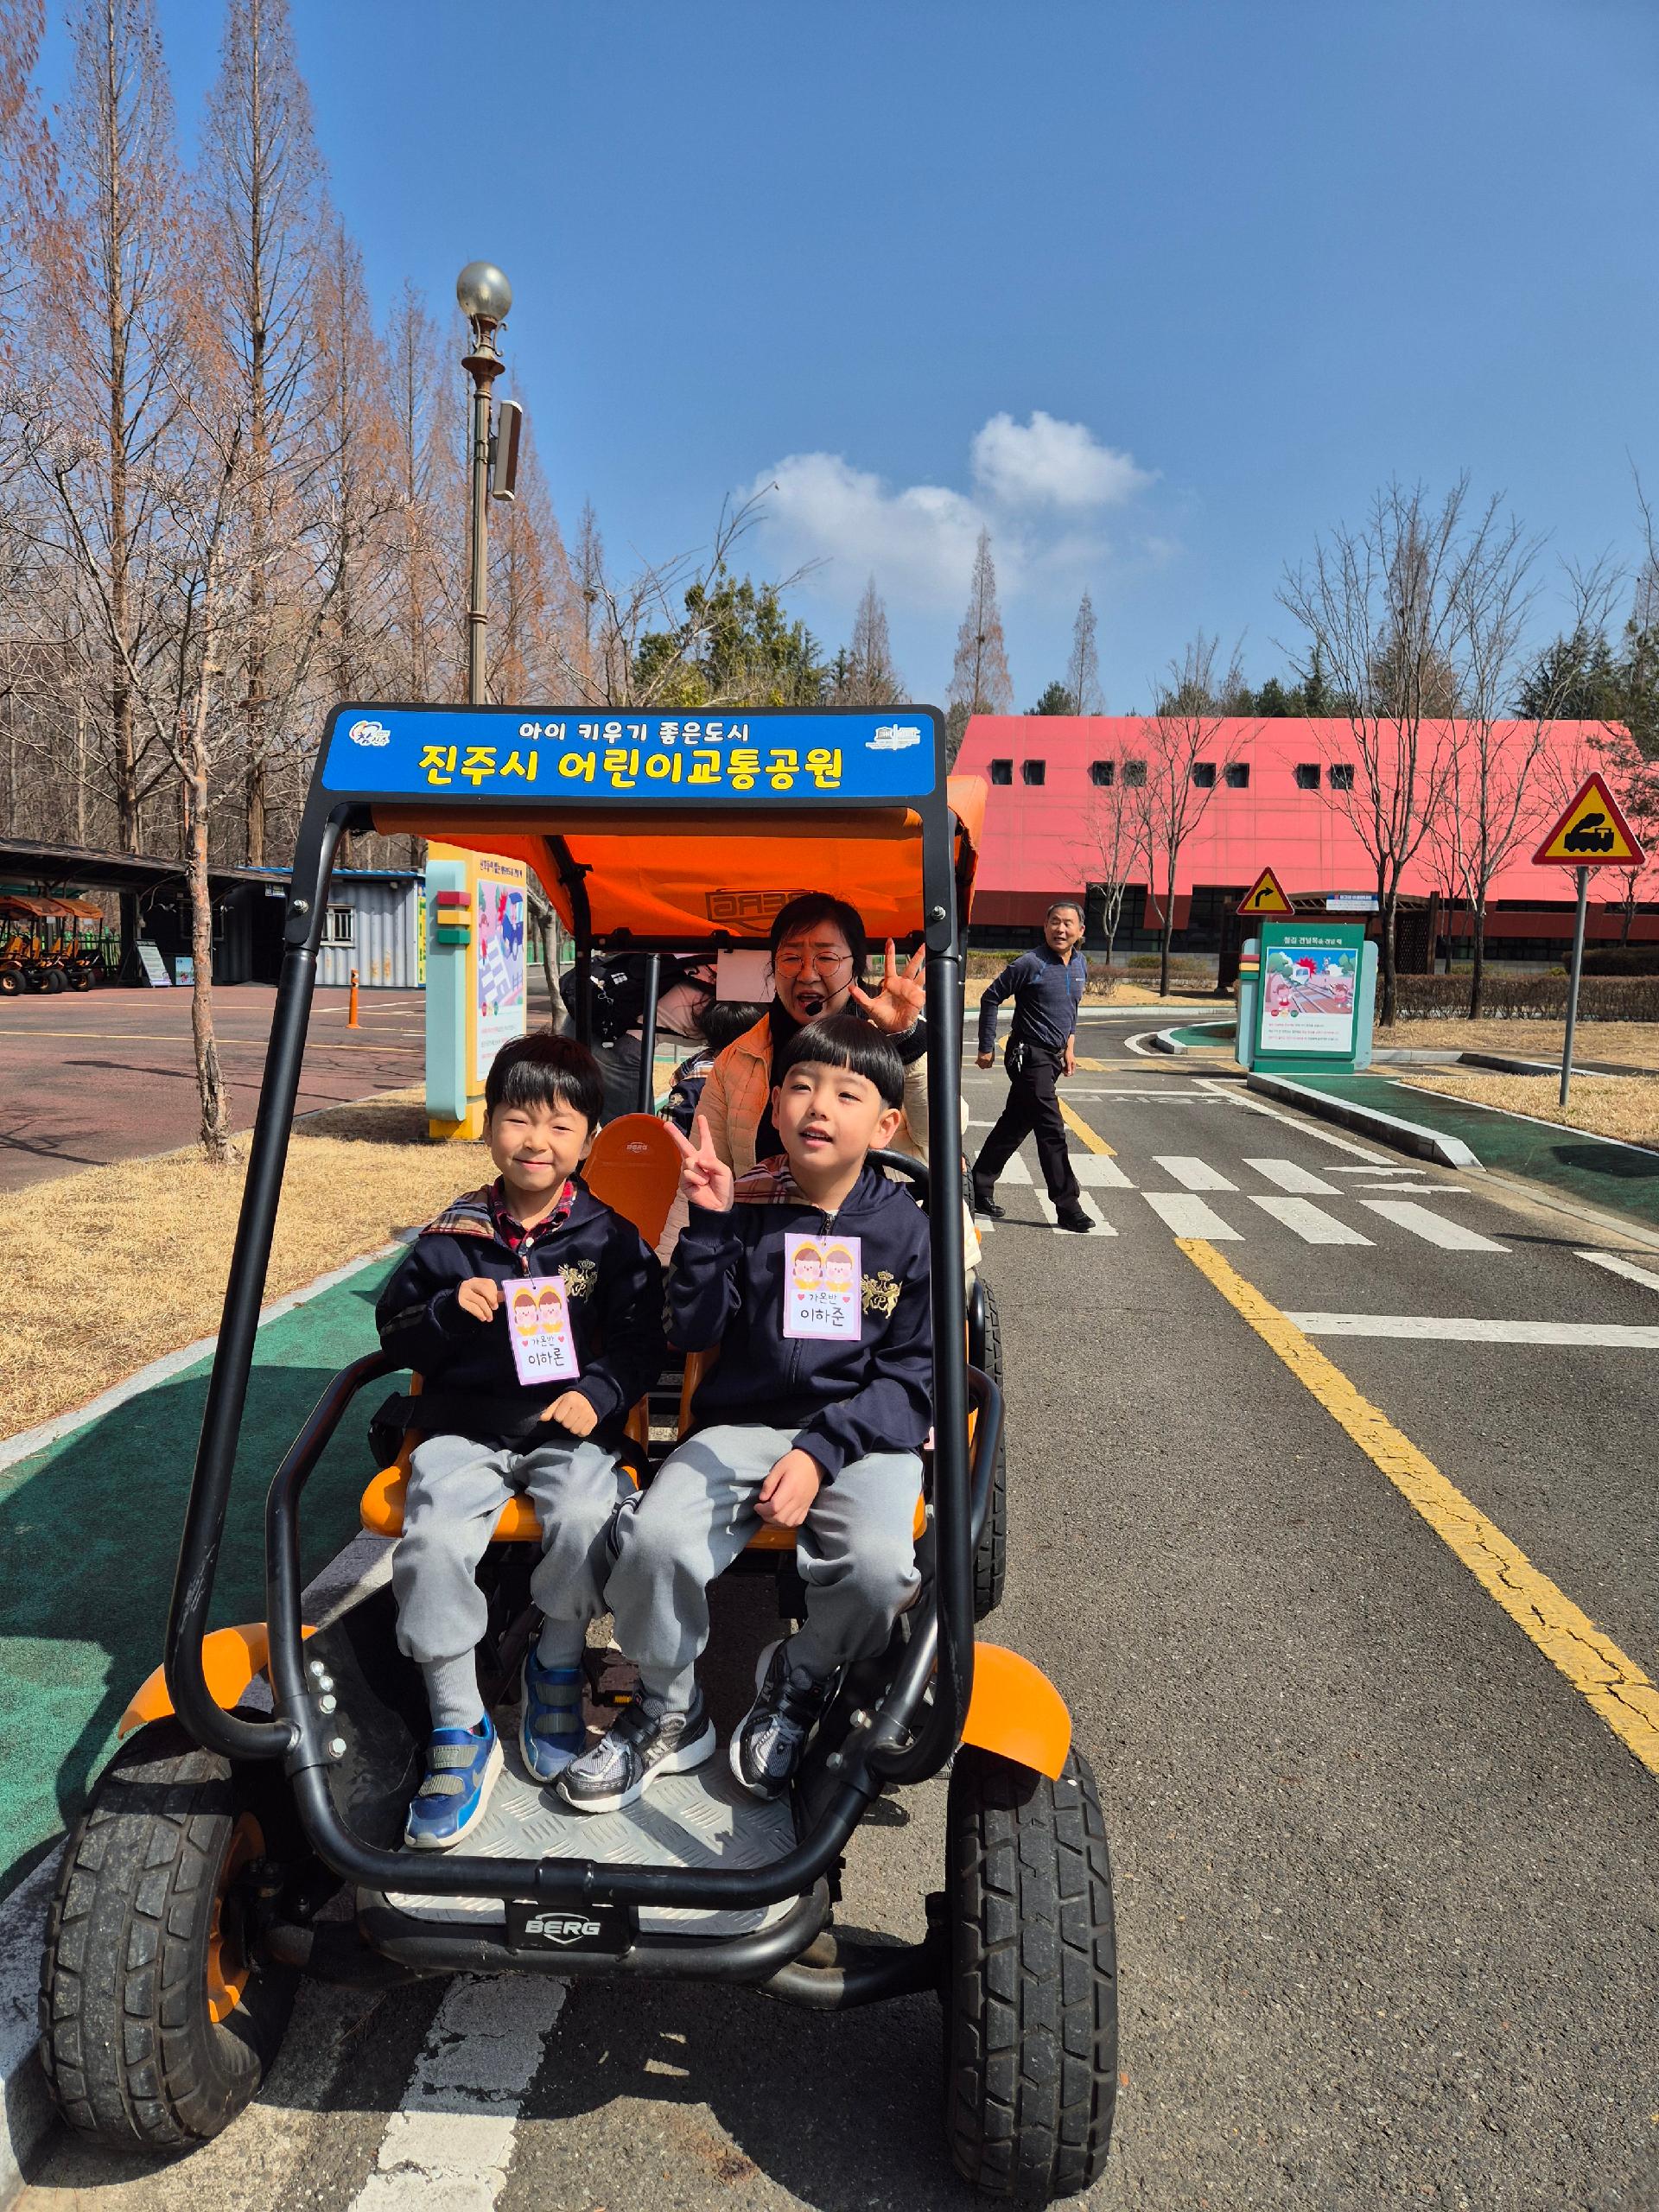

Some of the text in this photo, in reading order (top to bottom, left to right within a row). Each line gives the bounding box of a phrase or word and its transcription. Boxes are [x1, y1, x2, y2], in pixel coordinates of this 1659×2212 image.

[518, 721, 749, 746] 아이 키우기 좋은도시
[418, 744, 844, 791] 진주시 어린이교통공원
[809, 1292, 837, 1306] 가온반
[800, 1306, 845, 1326] 이하준
[528, 1347, 565, 1367] 이하론
[525, 1920, 601, 1936] BERG
